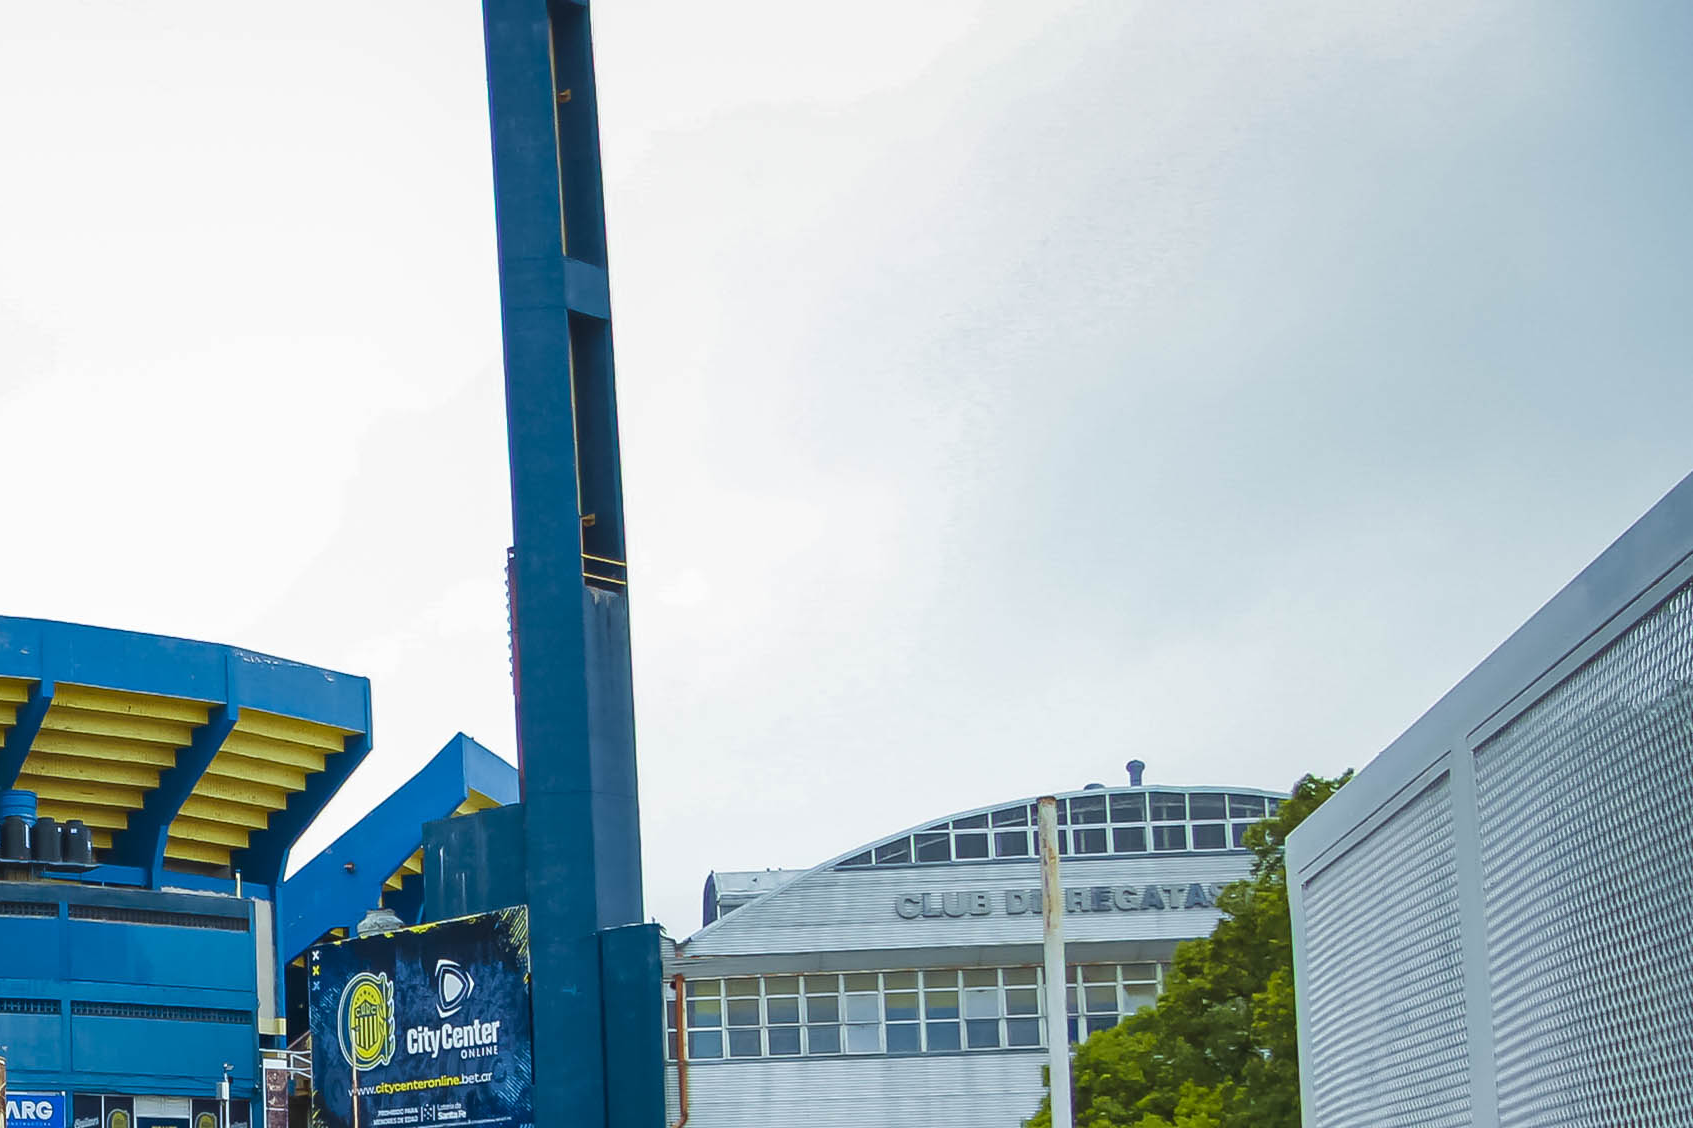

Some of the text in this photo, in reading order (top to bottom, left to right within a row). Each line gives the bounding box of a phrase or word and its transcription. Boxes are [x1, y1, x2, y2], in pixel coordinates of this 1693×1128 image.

[895, 892, 991, 920] CLUB
[460, 1045, 499, 1060] ONLINE
[348, 1071, 493, 1098] www.citycenteronline.bet.ar
